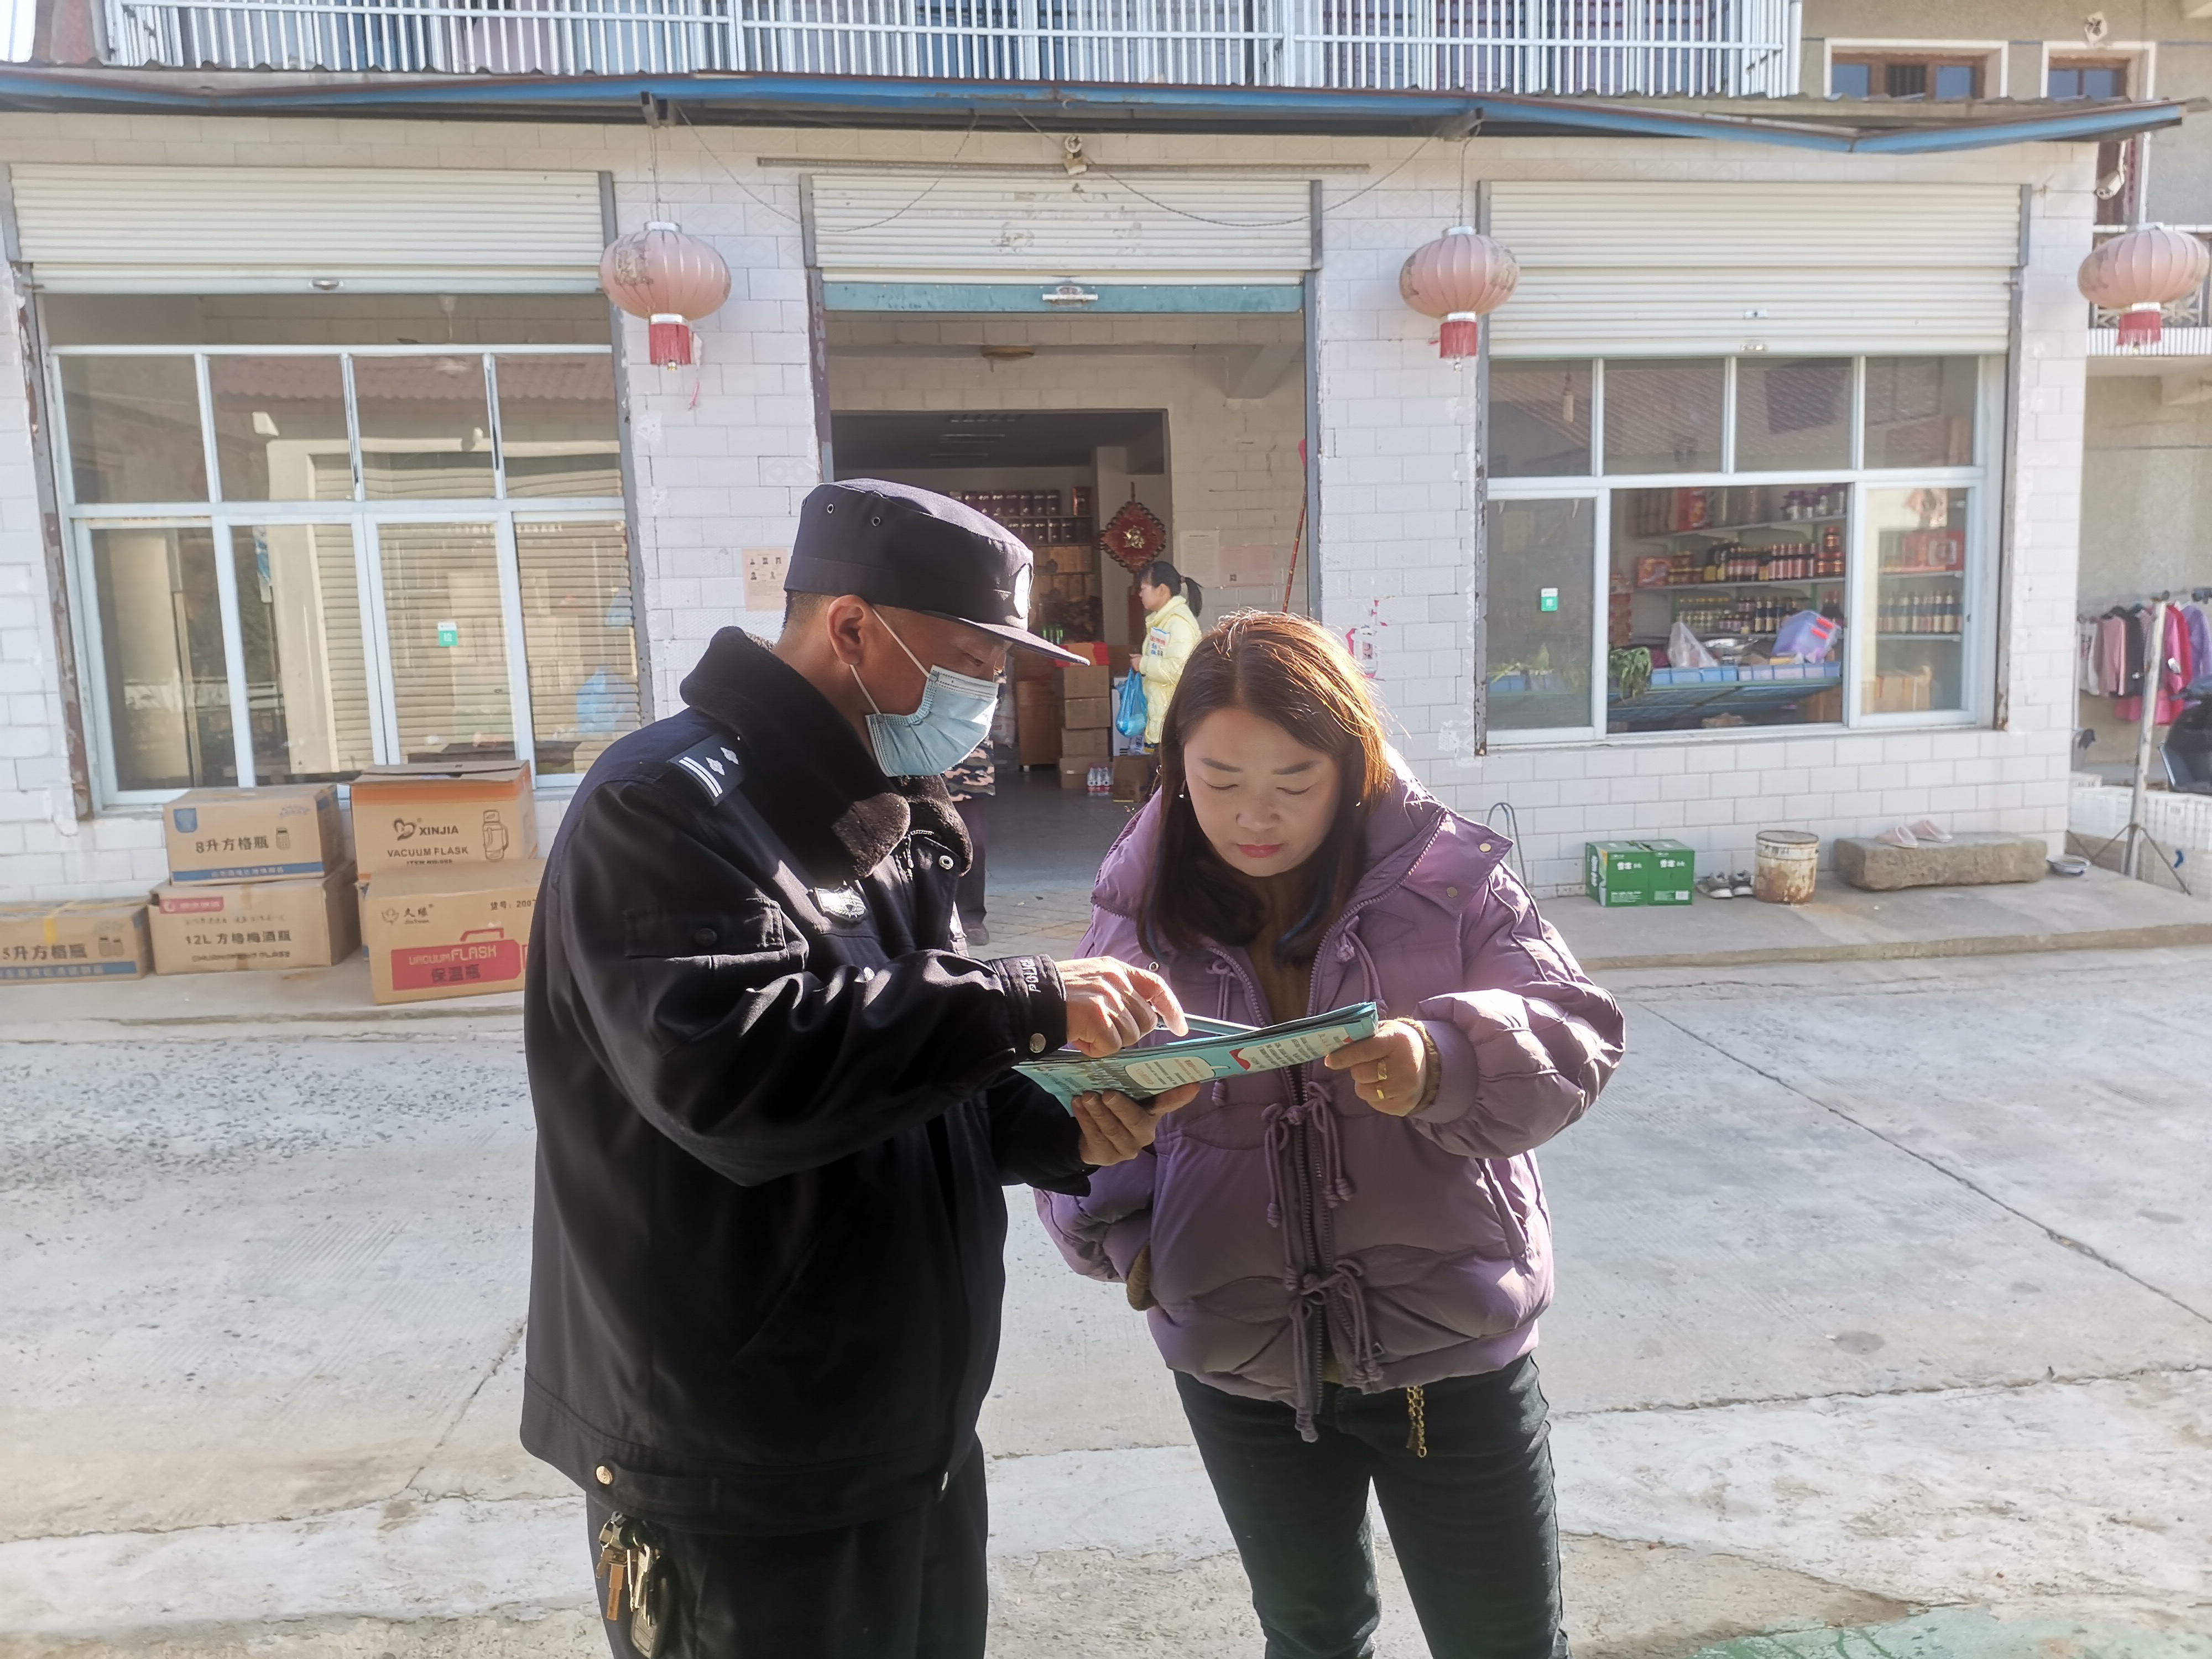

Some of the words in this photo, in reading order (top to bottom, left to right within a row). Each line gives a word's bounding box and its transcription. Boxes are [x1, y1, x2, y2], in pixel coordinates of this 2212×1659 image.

[419, 825, 459, 836] XINJIA
[195, 835, 269, 853] 8升方格瓶
[387, 849, 431, 858] VACUUM
[434, 846, 468, 855] FLASK
[451, 945, 497, 962] FLASK
[431, 963, 481, 984] 保温瓶
[1020, 958, 1041, 993] POLICE
